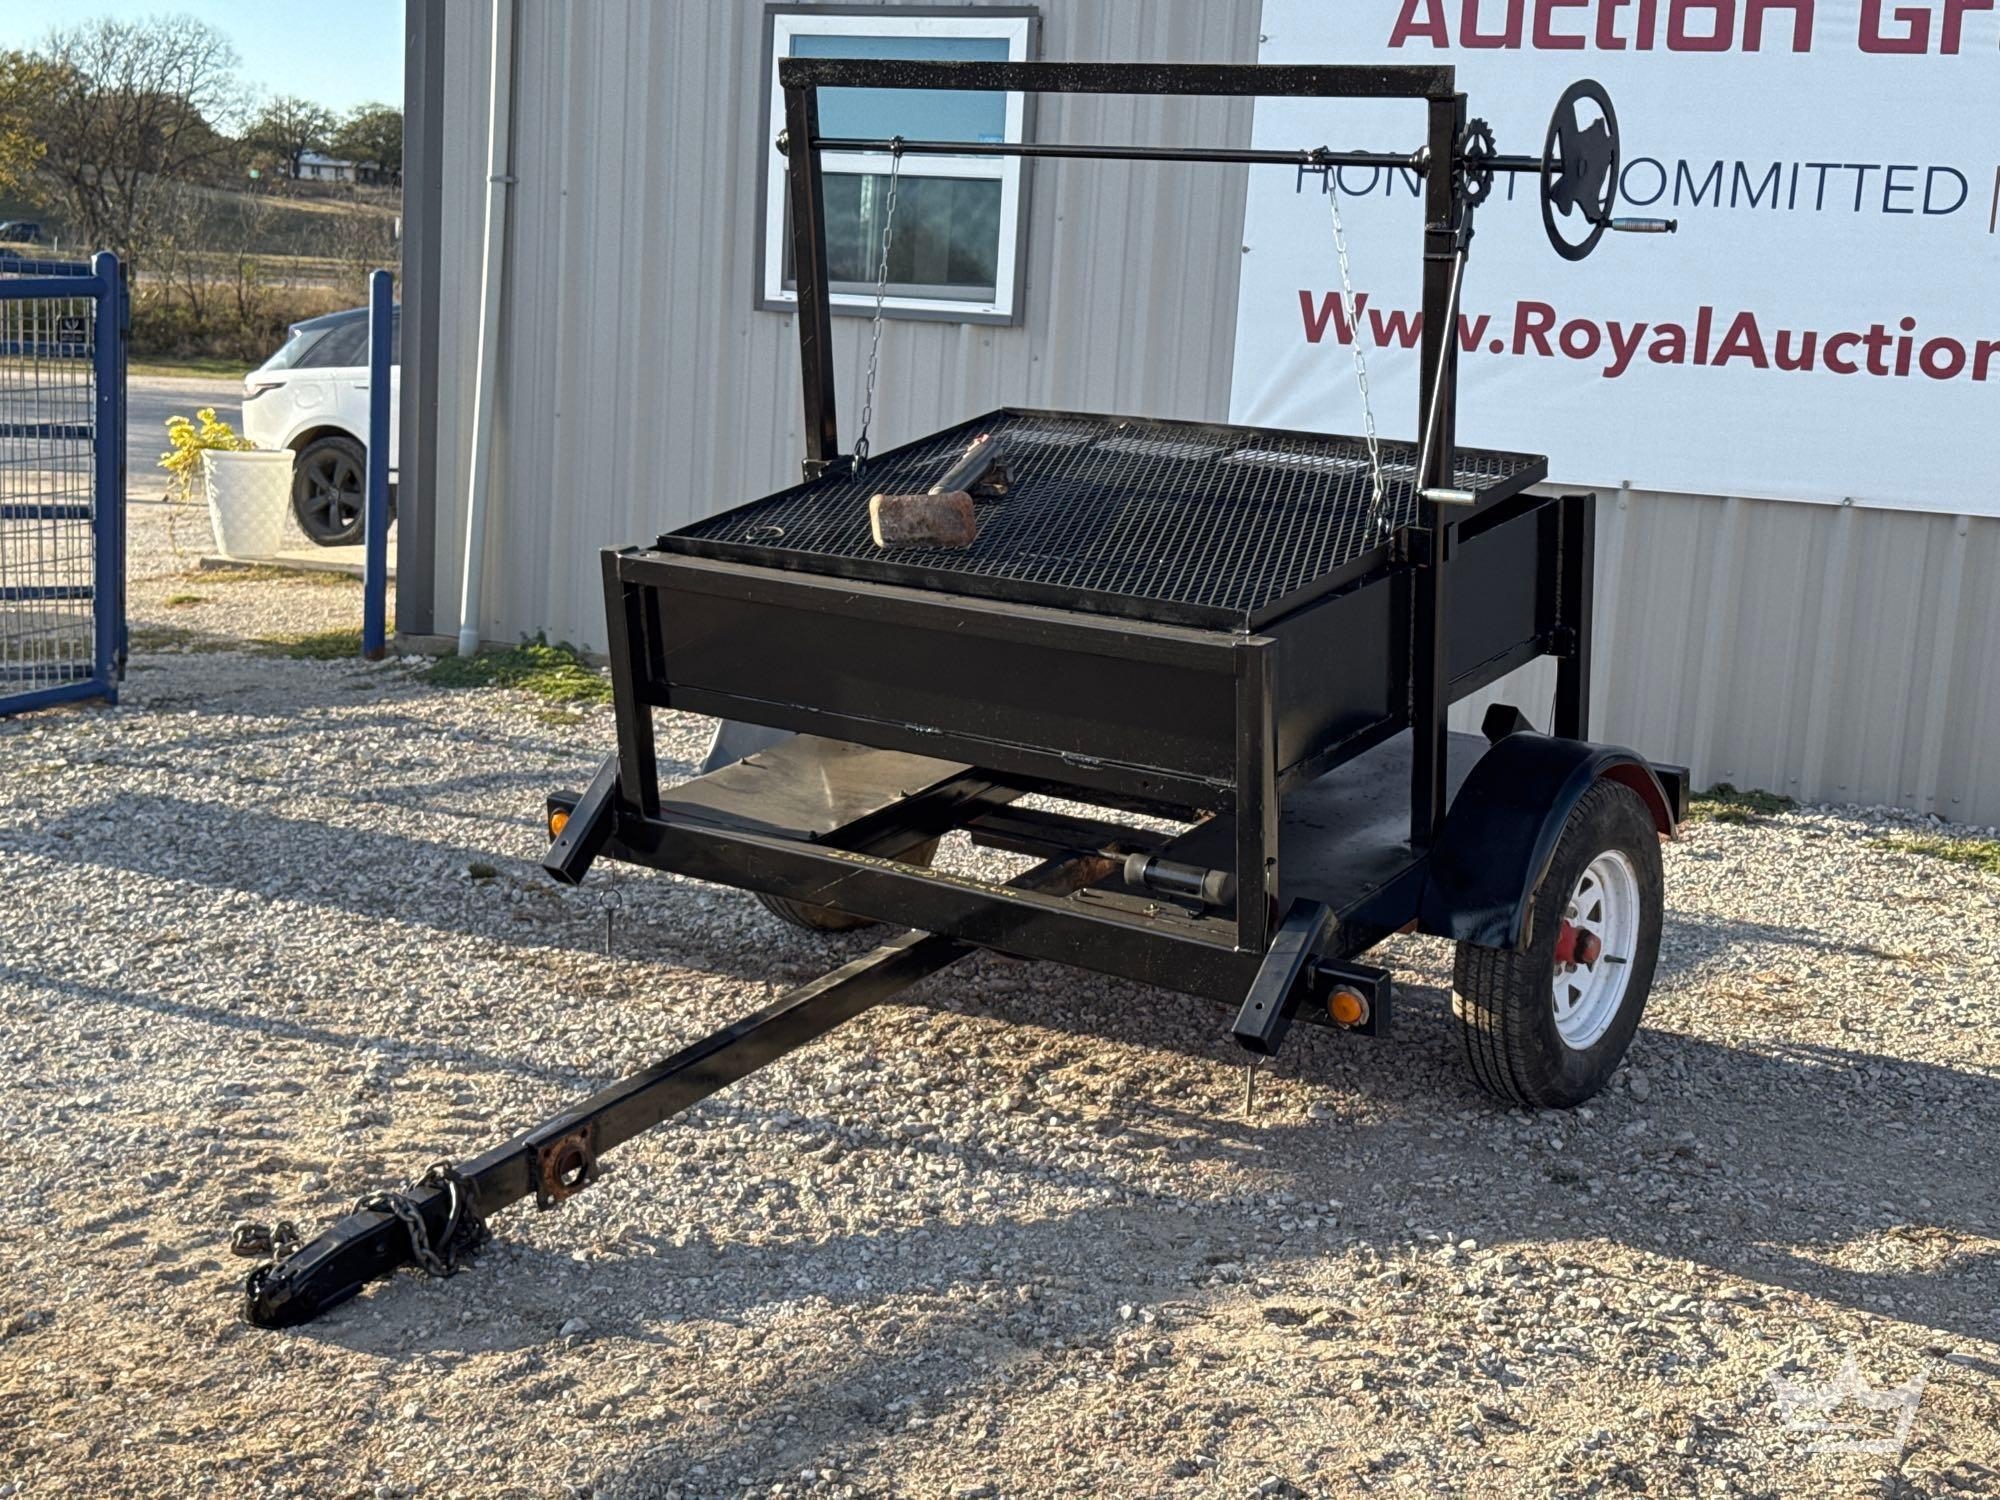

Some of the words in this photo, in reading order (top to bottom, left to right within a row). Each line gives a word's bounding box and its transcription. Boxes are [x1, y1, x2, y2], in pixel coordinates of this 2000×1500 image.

[1388, 0, 1814, 52] Auction
[1858, 0, 2000, 54] Gr
[1297, 149, 1532, 201] HONT
[1552, 157, 1969, 215] OMMITTED
